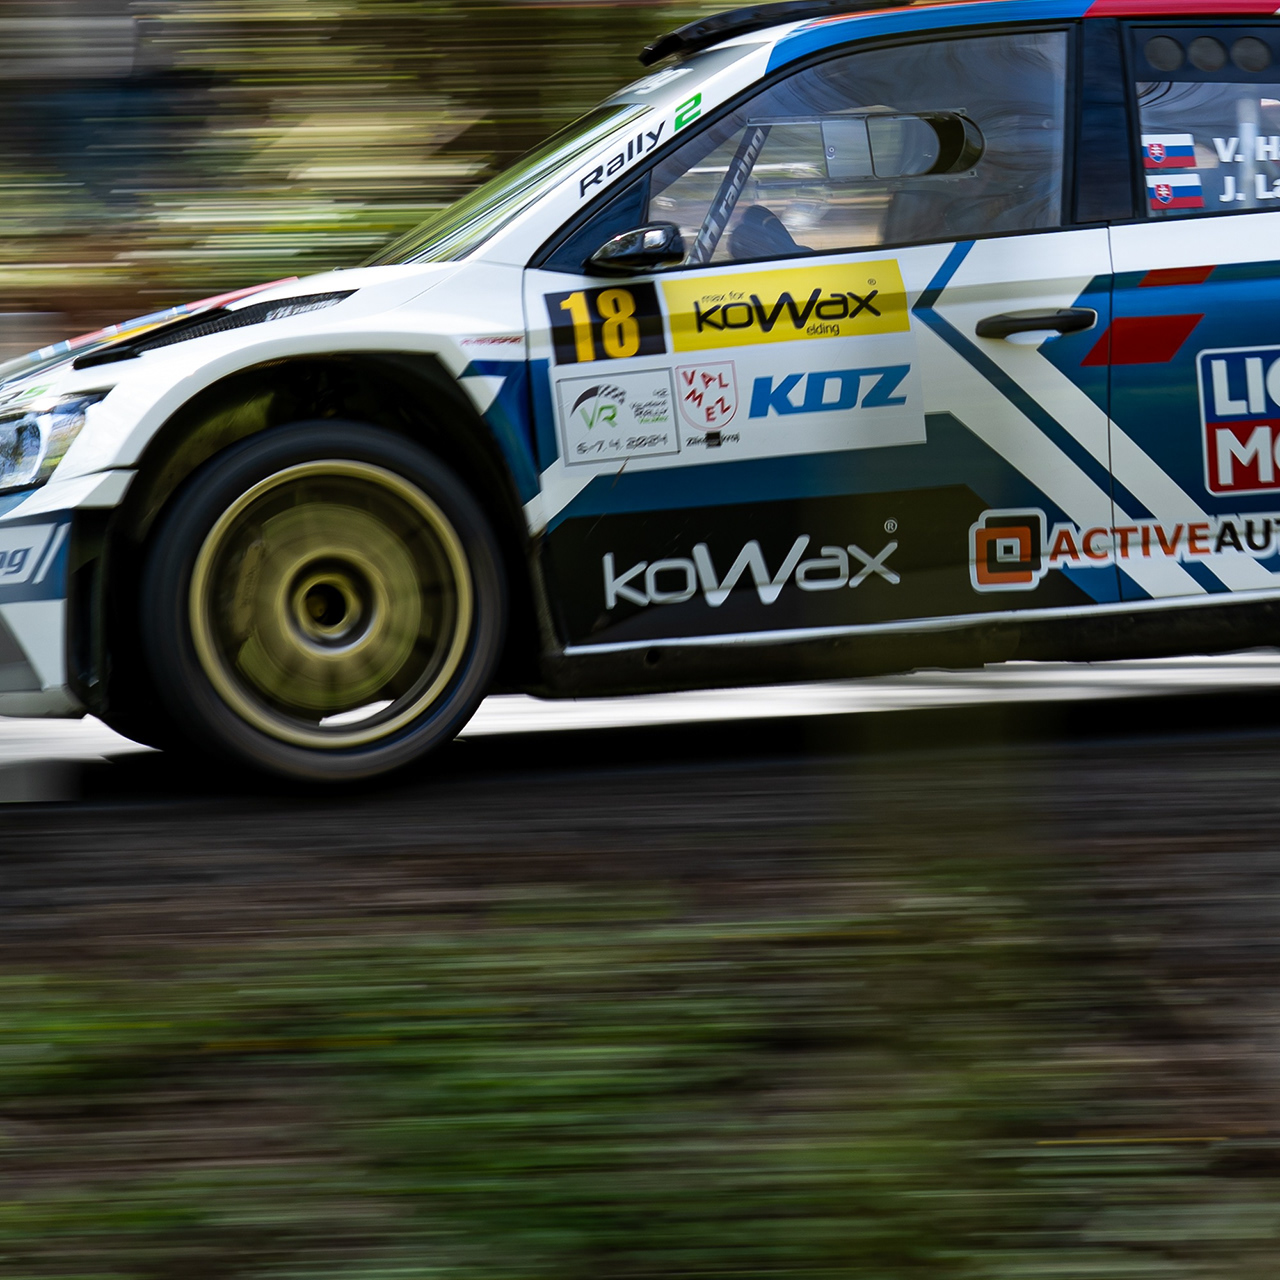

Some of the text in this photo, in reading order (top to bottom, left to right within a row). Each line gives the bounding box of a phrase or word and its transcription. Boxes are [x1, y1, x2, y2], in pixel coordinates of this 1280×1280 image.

[579, 92, 702, 199] Rally 2
[1212, 137, 1245, 162] V.
[1219, 176, 1246, 202] J.
[560, 289, 640, 362] 18
